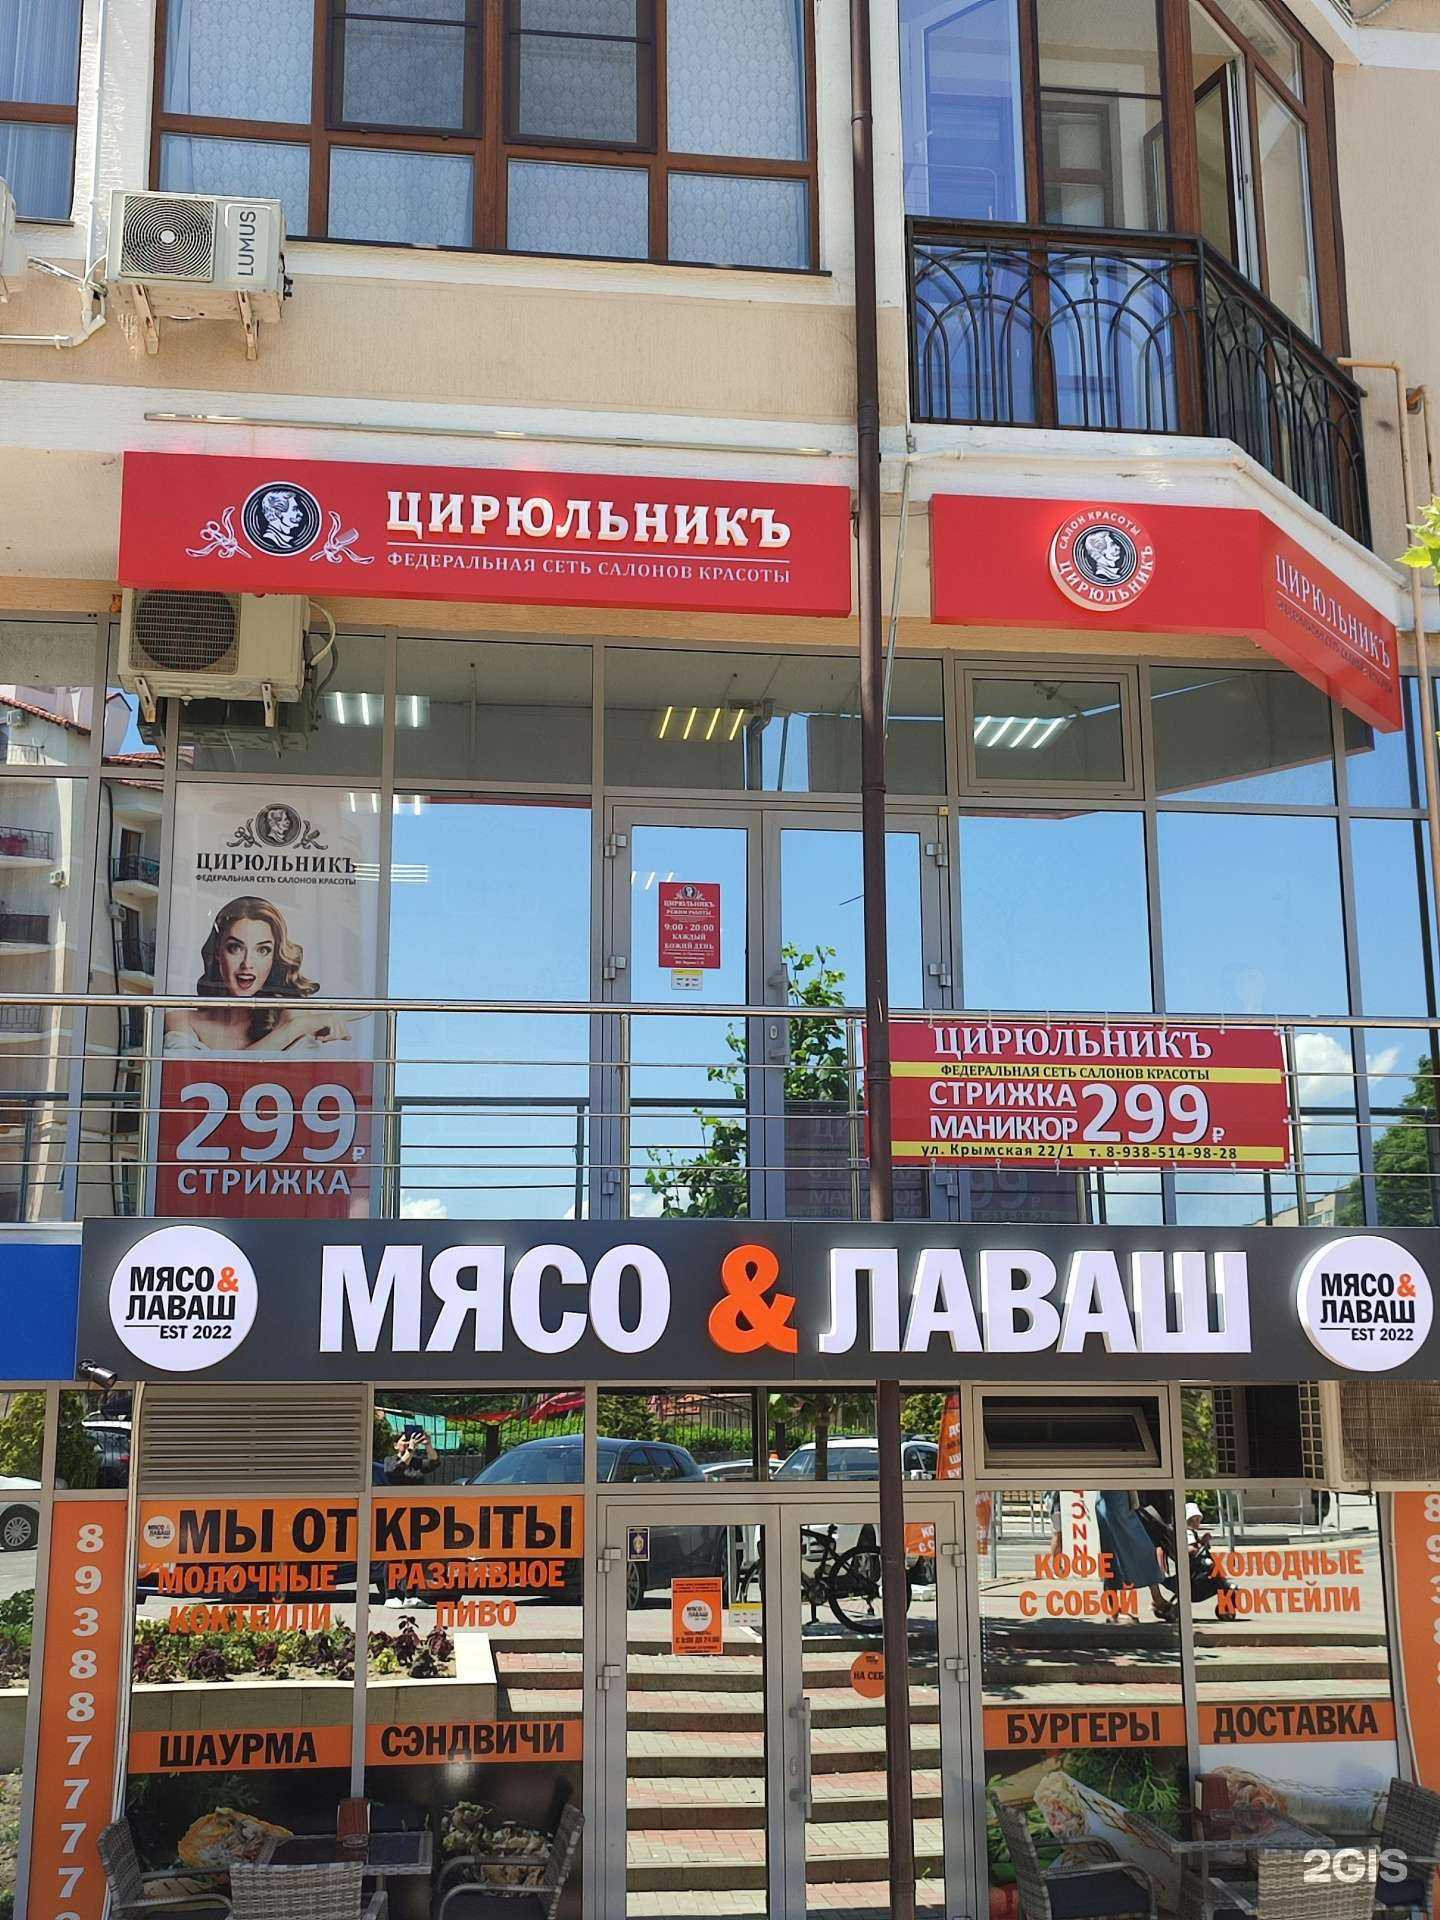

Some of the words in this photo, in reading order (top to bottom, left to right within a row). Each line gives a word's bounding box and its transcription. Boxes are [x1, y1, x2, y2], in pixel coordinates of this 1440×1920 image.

[238, 211, 256, 276] LUMUS
[387, 491, 791, 548] ЦИРЮЛЬНИКЪ
[1060, 515, 1086, 549] САЛОН
[1087, 511, 1141, 536] КРАСОТЫ
[387, 551, 536, 573] ФЕДЕРАЛЬНАЯ
[542, 559, 592, 575] СЕТЬ
[598, 561, 692, 580] САЛОНОВ
[699, 566, 791, 584] КРАСОТЫ
[1059, 546, 1153, 602] ЦИРЮЛЬНИКЪ
[1275, 554, 1391, 669] ЦИРЮЛЬНИКЪ
[196, 853, 357, 874] ЦИРЮЛЬНИКЪ
[195, 874, 255, 883] ФЕДЕРАЛЬНАЯ
[256, 875, 276, 884] СЕТЬ
[277, 876, 317, 885] САЛОНОВ
[318, 878, 357, 886] КРАСОТЫ
[933, 1026, 1212, 1061] ЦИРЮЛЬНИКЪ
[941, 1064, 1040, 1077] ФЕДЕРАЛЬНАЯ
[1043, 1065, 1077, 1078] СЕТЬ
[1079, 1066, 1144, 1079] САЛОНОВ
[1148, 1068, 1210, 1080] КРАСОТЫ
[929, 1081, 1077, 1107] СТРИЖКА
[930, 1115, 1079, 1141] МАНИКЮР
[921, 1144, 944, 1156] ул.
[950, 1143, 1032, 1157] Крымская
[1038, 1144, 1074, 1159] 22/1
[1089, 1148, 1101, 1158] т.
[1106, 1146, 1237, 1159] 8-938-514-98-28
[177, 1168, 351, 1195] СТРИЖКА
[126, 1295, 236, 1321] ЛАВАШ
[319, 1243, 672, 1354] МЯСО
[708, 1243, 798, 1354] &
[818, 1247, 1252, 1354] ЛАВАШ
[1320, 1300, 1416, 1323] ЛАВАШ
[160, 1325, 188, 1339] EST
[192, 1325, 232, 1339] 2022
[1352, 1328, 1376, 1341] EST
[1380, 1328, 1414, 1341] 2022
[179, 1508, 275, 1554] МЫ
[158, 1565, 337, 1594] МОЛОЧНЫЕ
[388, 1560, 565, 1590] РАЗЛИВНОЕ
[1034, 1552, 1114, 1580] КОФЕ
[1211, 1550, 1364, 1581] ХОЛОДНЫЕ
[436, 1600, 517, 1628] ПИВО
[1020, 1590, 1038, 1617] С
[1046, 1582, 1138, 1617] СОБОЙ
[1217, 1581, 1361, 1615] КОКТЕЙЛИ
[168, 1597, 332, 1634] КОКТЕЙЛИ
[1007, 1711, 1161, 1744] БУРГЕРЫ
[1213, 1704, 1378, 1743] ДОСТАВКА
[159, 1731, 318, 1767] ШАУРМА
[381, 1723, 565, 1760] СЭНДВИЧИ
